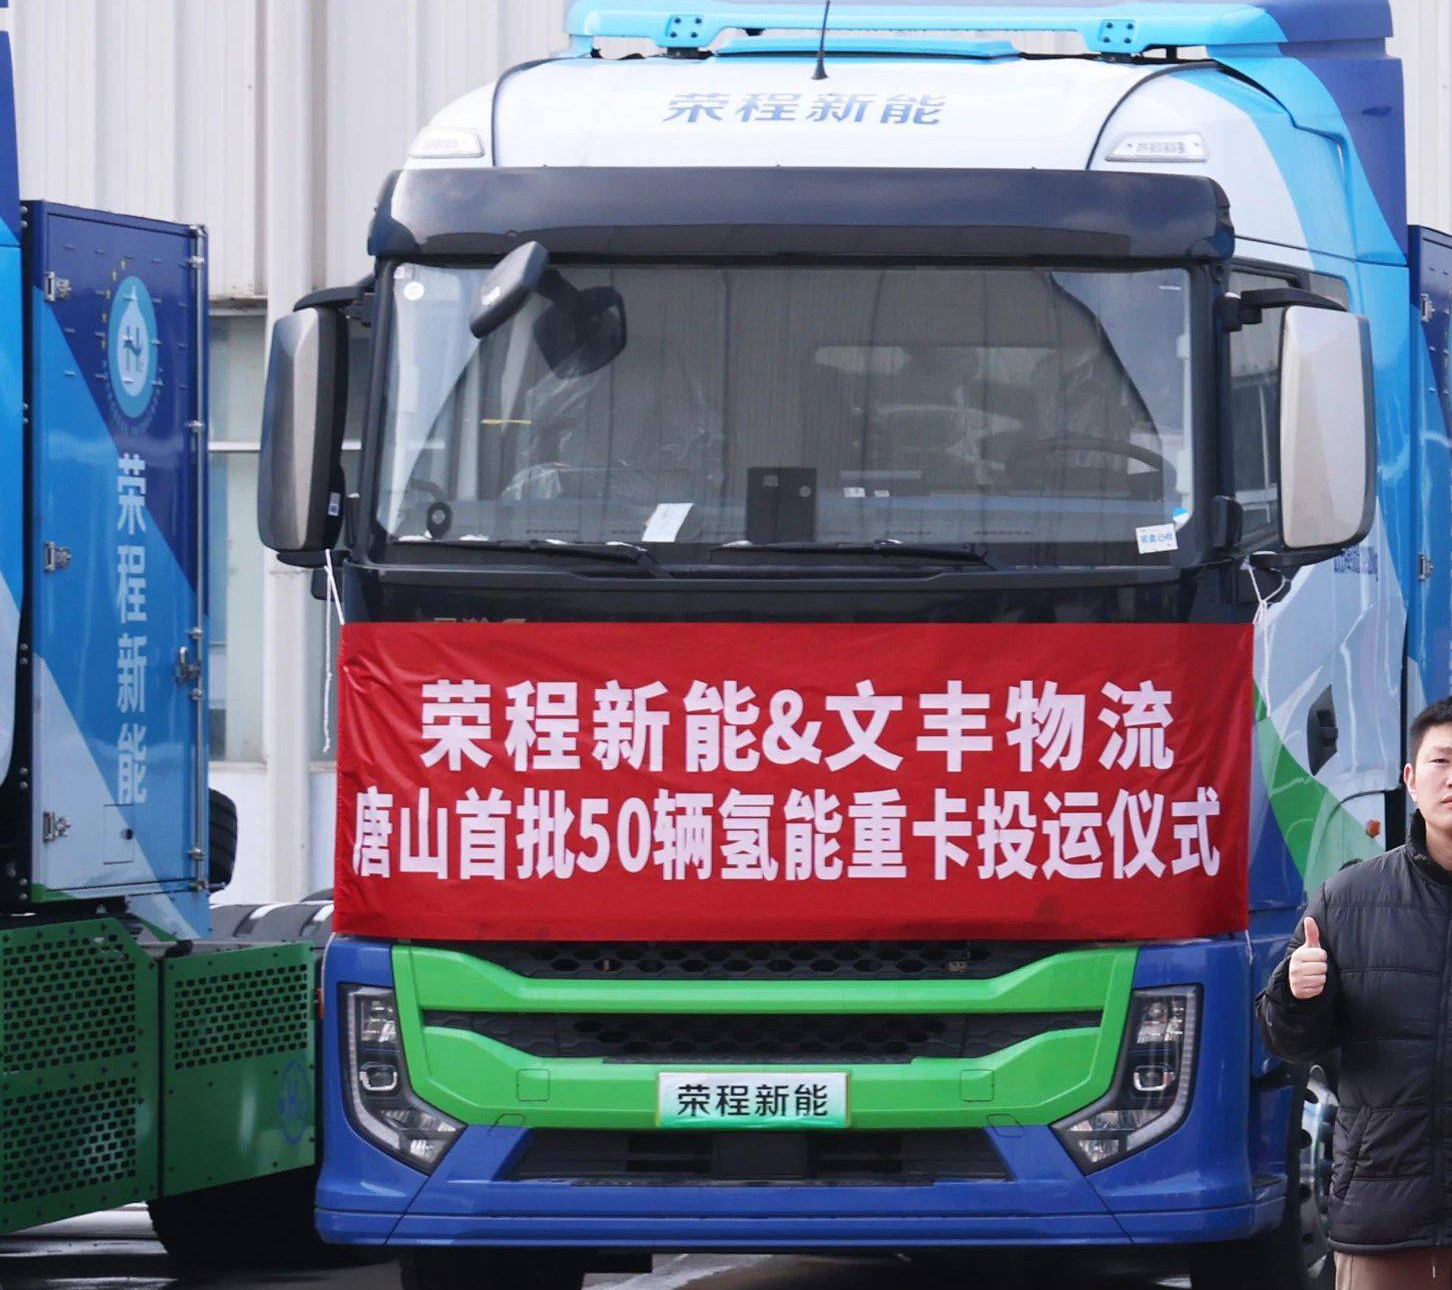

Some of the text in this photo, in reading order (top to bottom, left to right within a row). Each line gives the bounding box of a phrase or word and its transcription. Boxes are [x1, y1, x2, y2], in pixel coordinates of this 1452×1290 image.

[661, 92, 946, 126] 荣程新能
[115, 452, 149, 805] 荣程新能
[420, 679, 1175, 773] 荣程新能&文丰物流
[352, 785, 1221, 882] 唐山首批50辆氢能重卡投运仪式
[675, 1082, 829, 1119] 荣程新能
